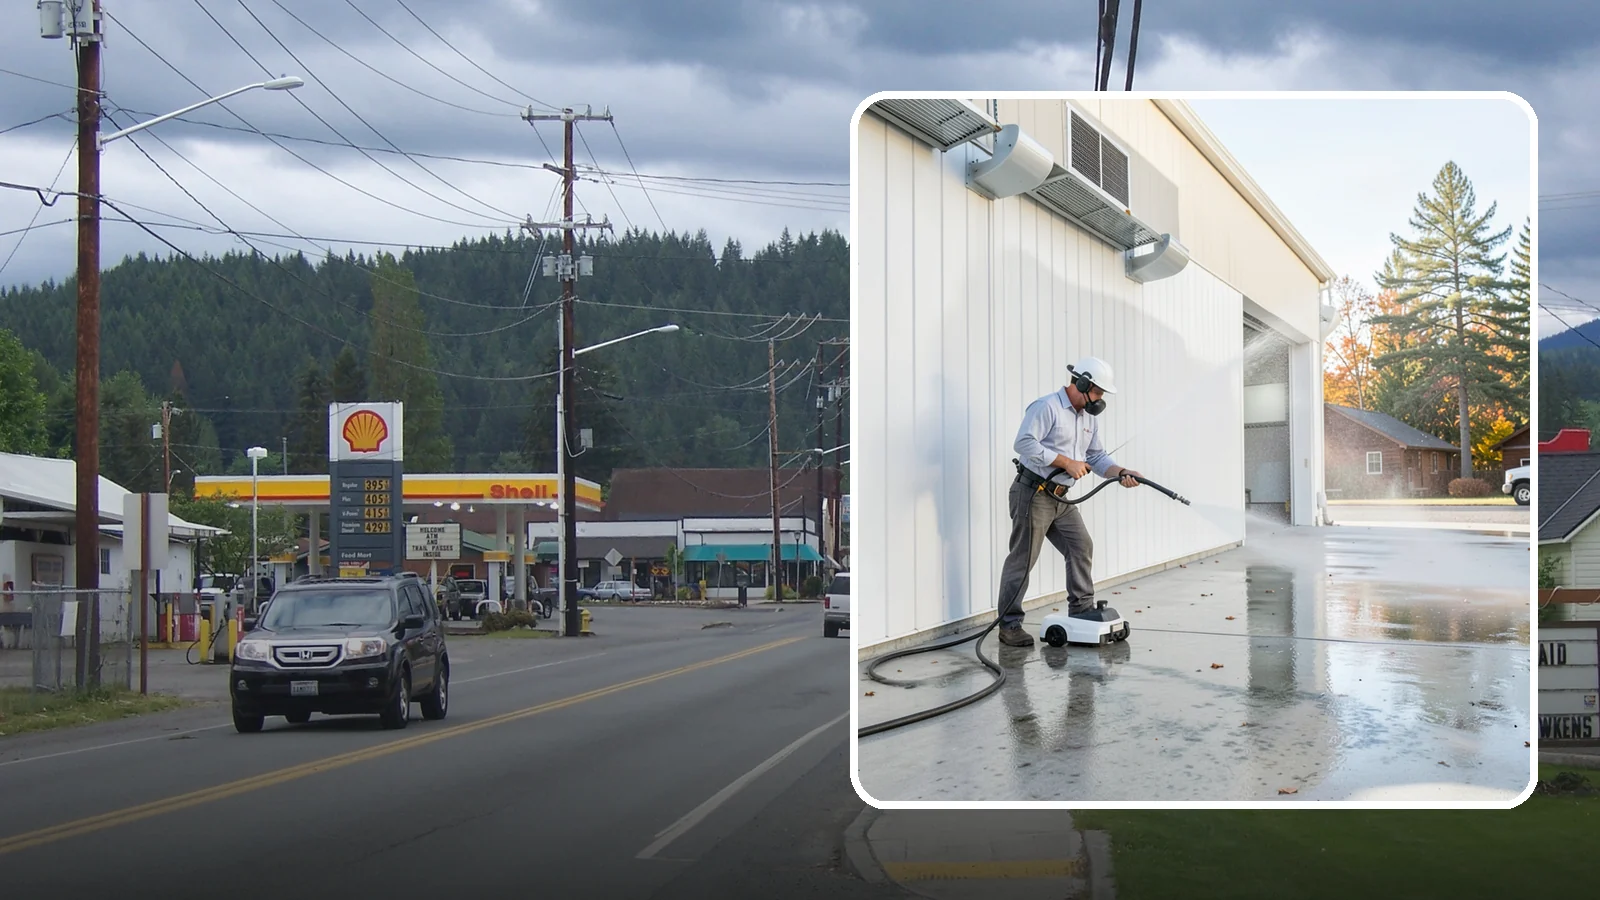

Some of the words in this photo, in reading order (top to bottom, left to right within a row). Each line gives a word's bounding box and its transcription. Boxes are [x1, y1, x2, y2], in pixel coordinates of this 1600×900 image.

[365, 479, 383, 490] 395
[490, 484, 547, 499] Shell
[365, 494, 383, 504] 405
[365, 508, 383, 518] 415
[365, 522, 383, 532] 429
[1538, 643, 1566, 665] AID
